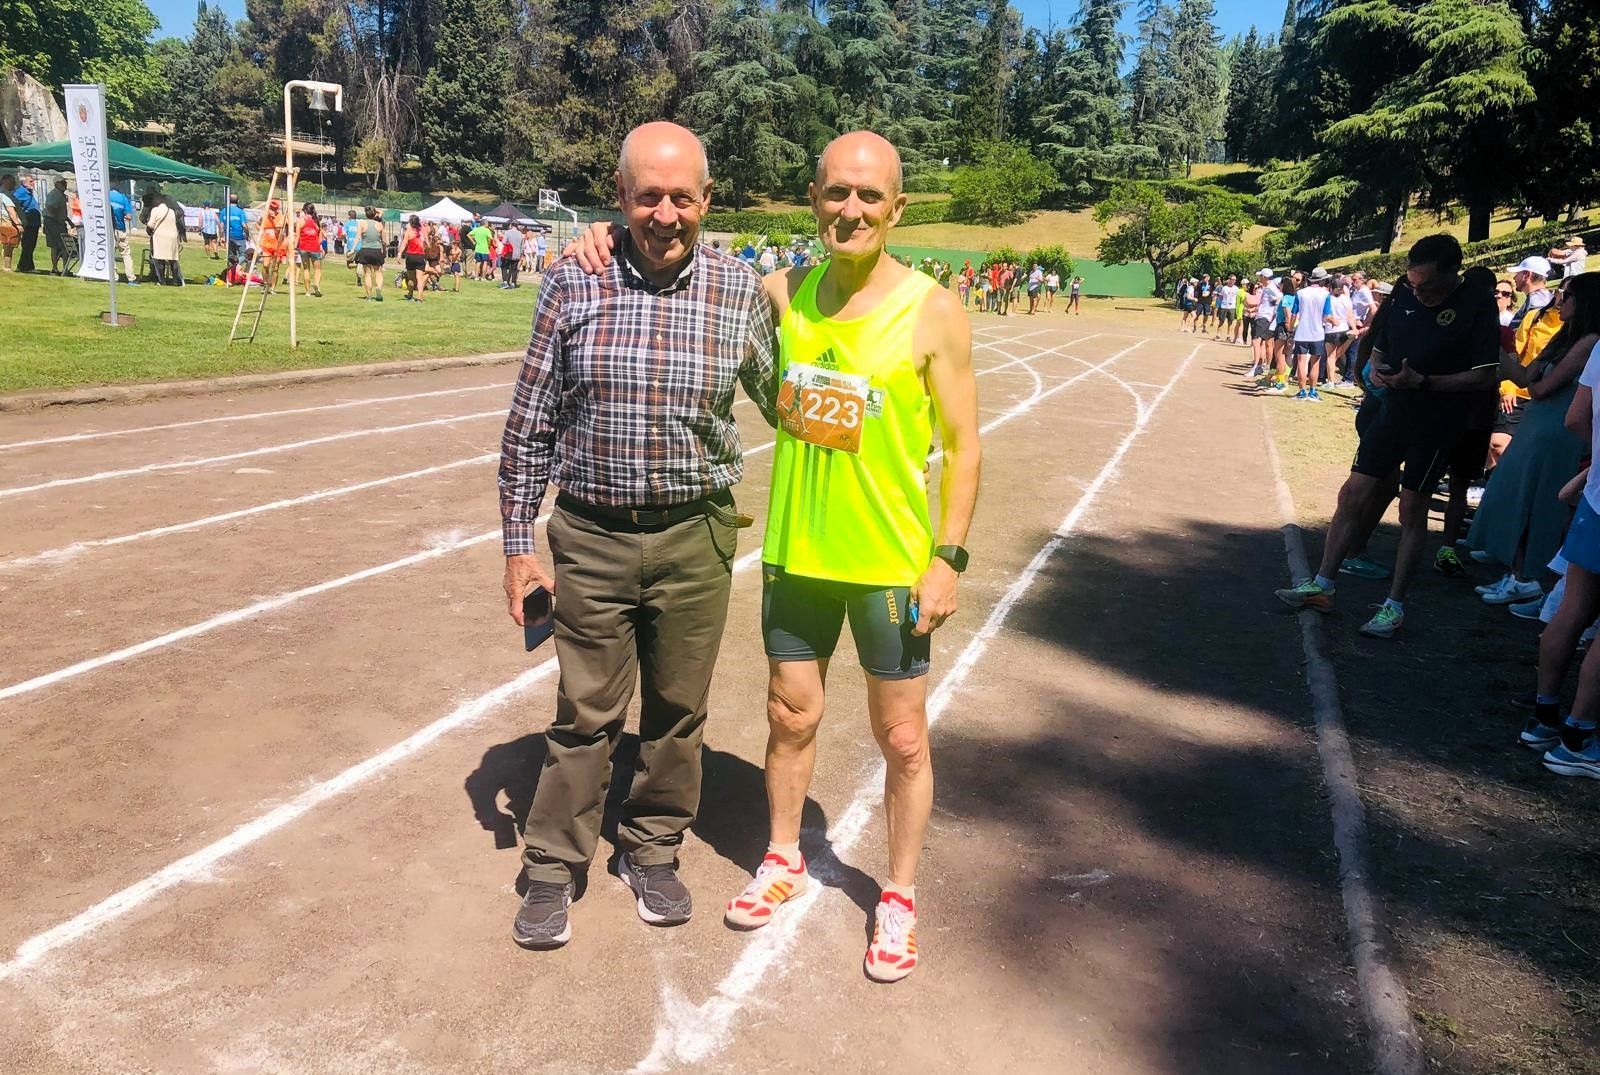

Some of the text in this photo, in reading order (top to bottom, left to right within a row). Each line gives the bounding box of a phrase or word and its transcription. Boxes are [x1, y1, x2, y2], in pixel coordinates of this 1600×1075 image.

[78, 137, 94, 269] UNIVERSIDAD
[85, 135, 106, 272] COMPLUTENSE
[811, 361, 840, 371] adidas
[804, 392, 859, 429] 223
